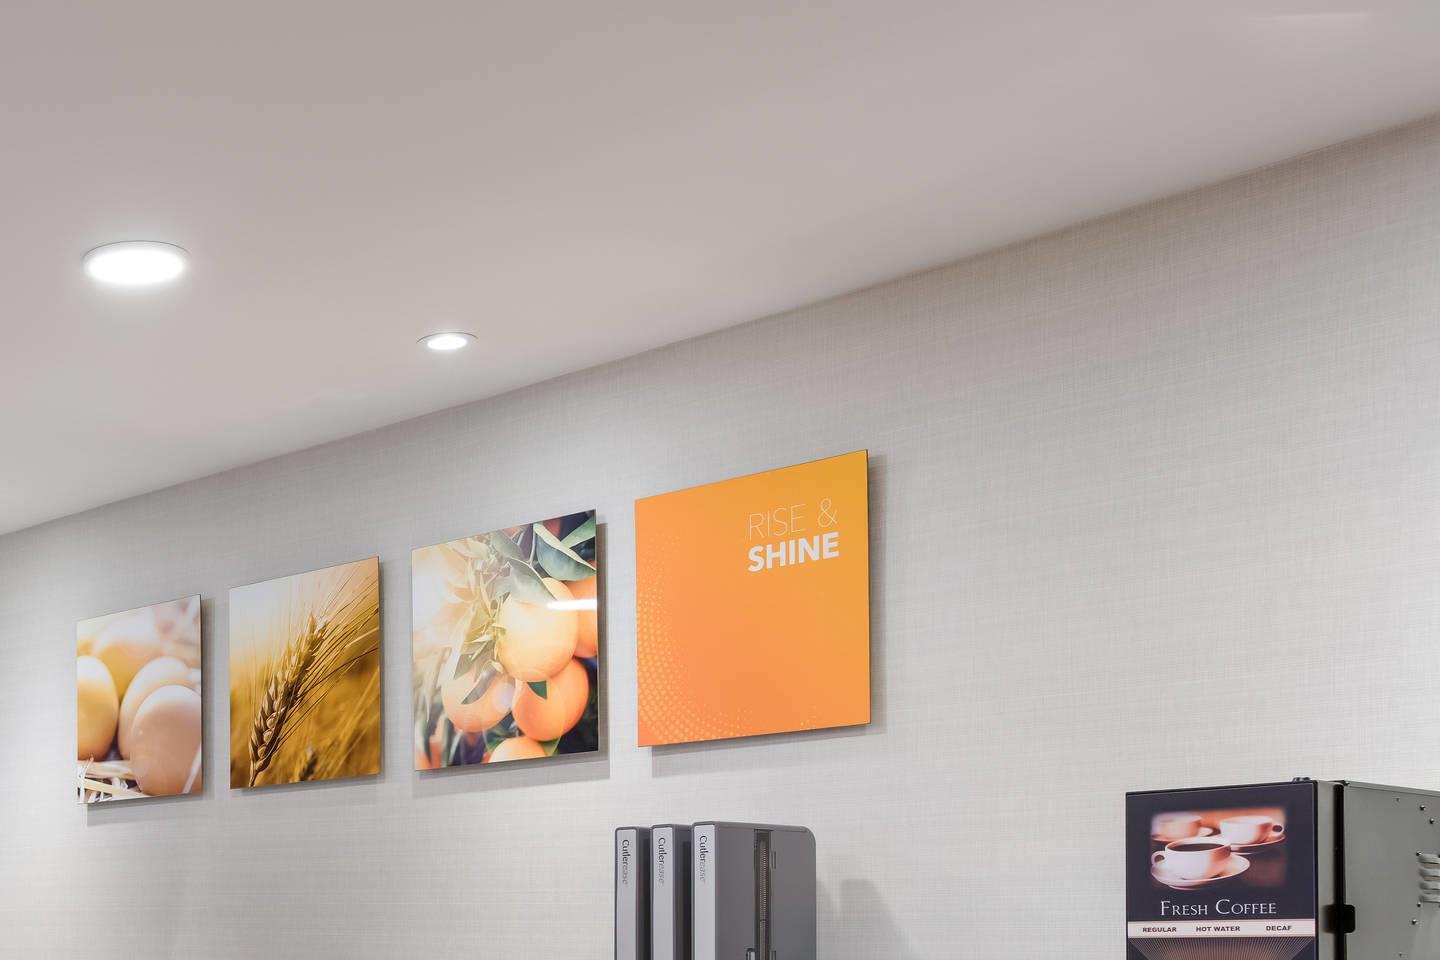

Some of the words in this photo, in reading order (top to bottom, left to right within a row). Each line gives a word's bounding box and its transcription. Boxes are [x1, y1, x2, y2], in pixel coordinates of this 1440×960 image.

[749, 504, 806, 540] RISE
[817, 498, 838, 528] &
[748, 532, 840, 572] SHINE
